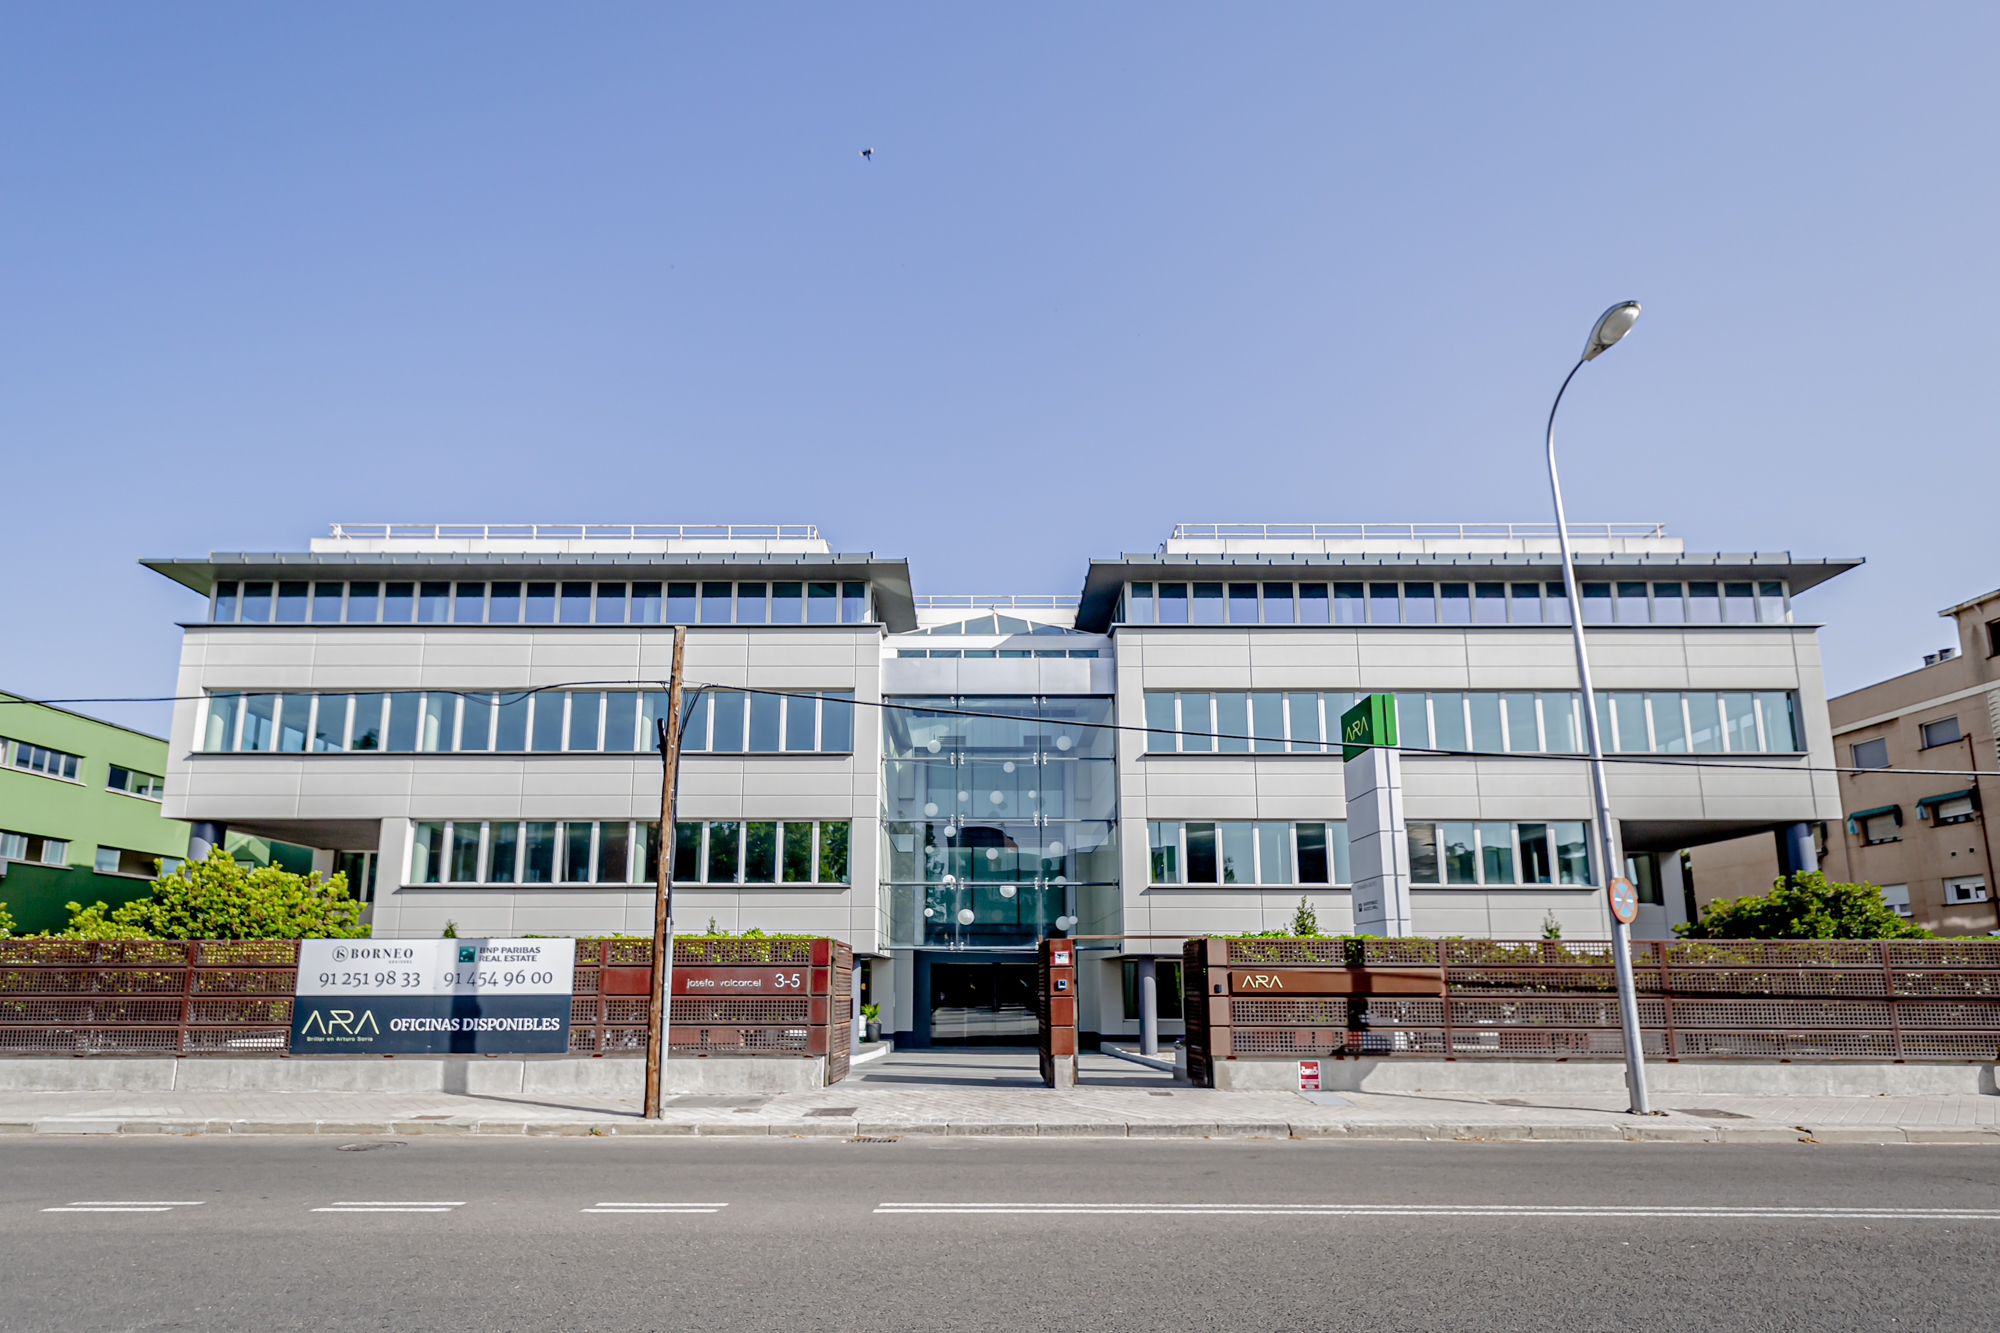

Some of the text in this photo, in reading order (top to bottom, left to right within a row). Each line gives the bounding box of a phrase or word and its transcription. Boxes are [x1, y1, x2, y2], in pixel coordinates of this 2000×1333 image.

[1345, 715, 1369, 743] ARA
[351, 948, 414, 959] BORNEO
[479, 946, 541, 954] BNP PARIBAS
[319, 970, 420, 988] 91 251 98 33
[444, 969, 553, 987] 91 454 96 00
[686, 978, 714, 989] josefa
[774, 973, 800, 988] 3-5
[1241, 975, 1283, 988] ARA
[301, 1010, 380, 1035] ARA
[390, 1017, 560, 1031] OFICINAS DISPONIBLES
